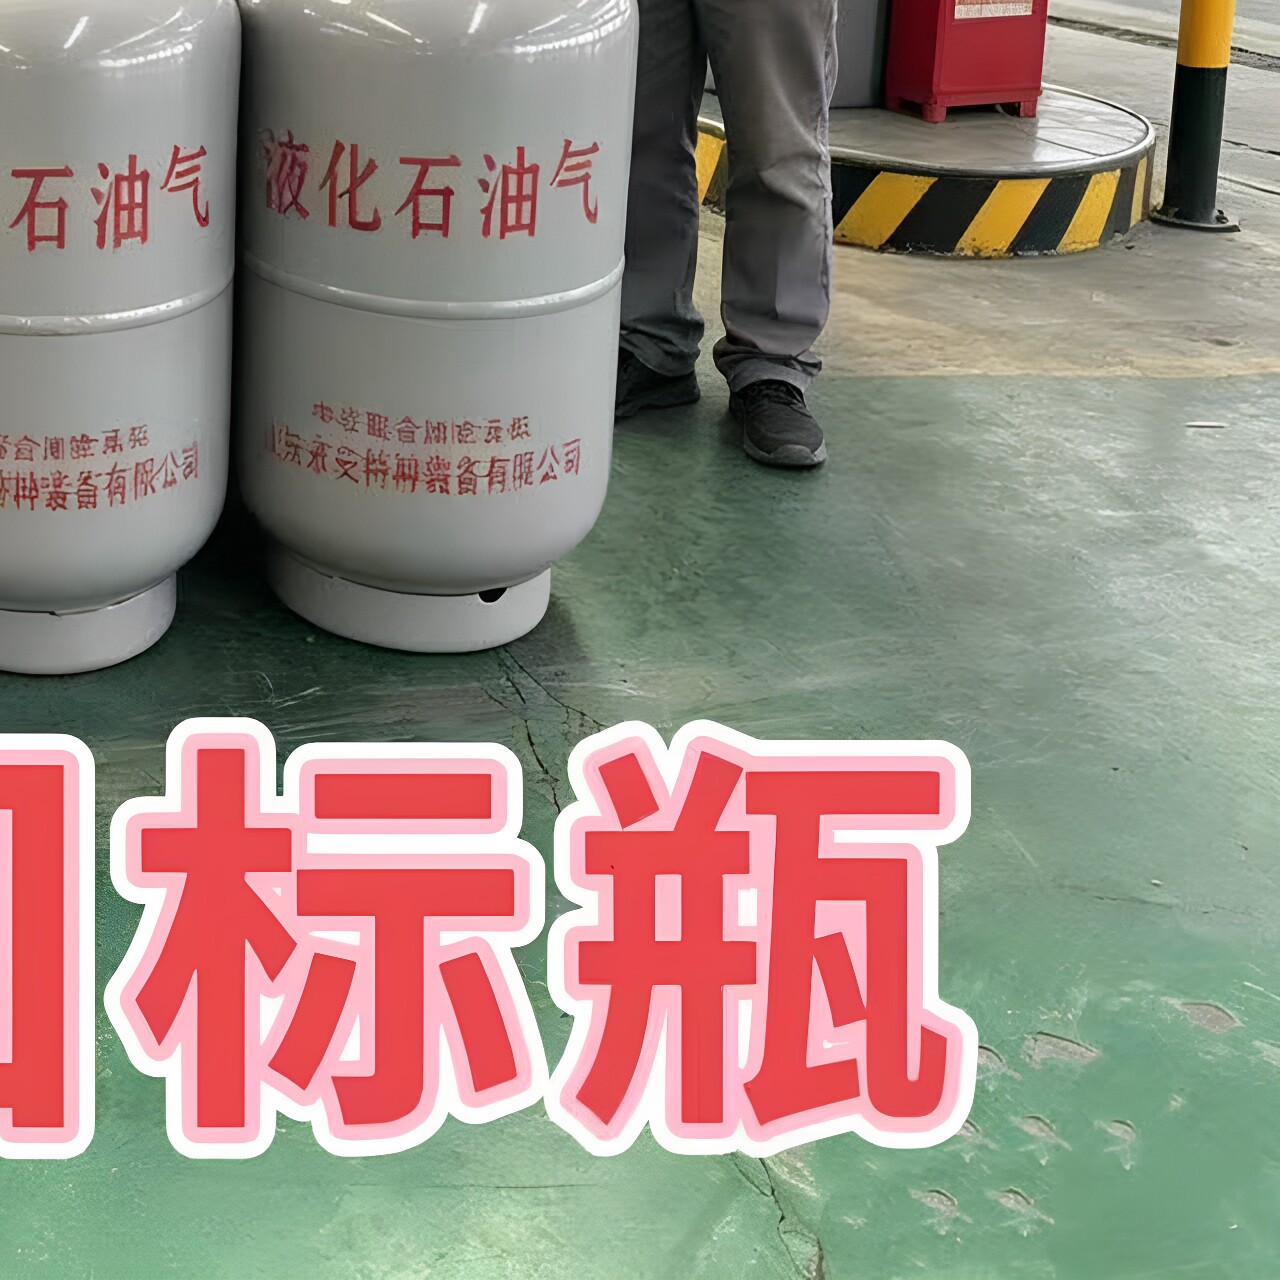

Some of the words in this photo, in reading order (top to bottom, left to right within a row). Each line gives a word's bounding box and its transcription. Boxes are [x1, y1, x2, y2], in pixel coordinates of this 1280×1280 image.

[266, 129, 601, 241] 液化石油气
